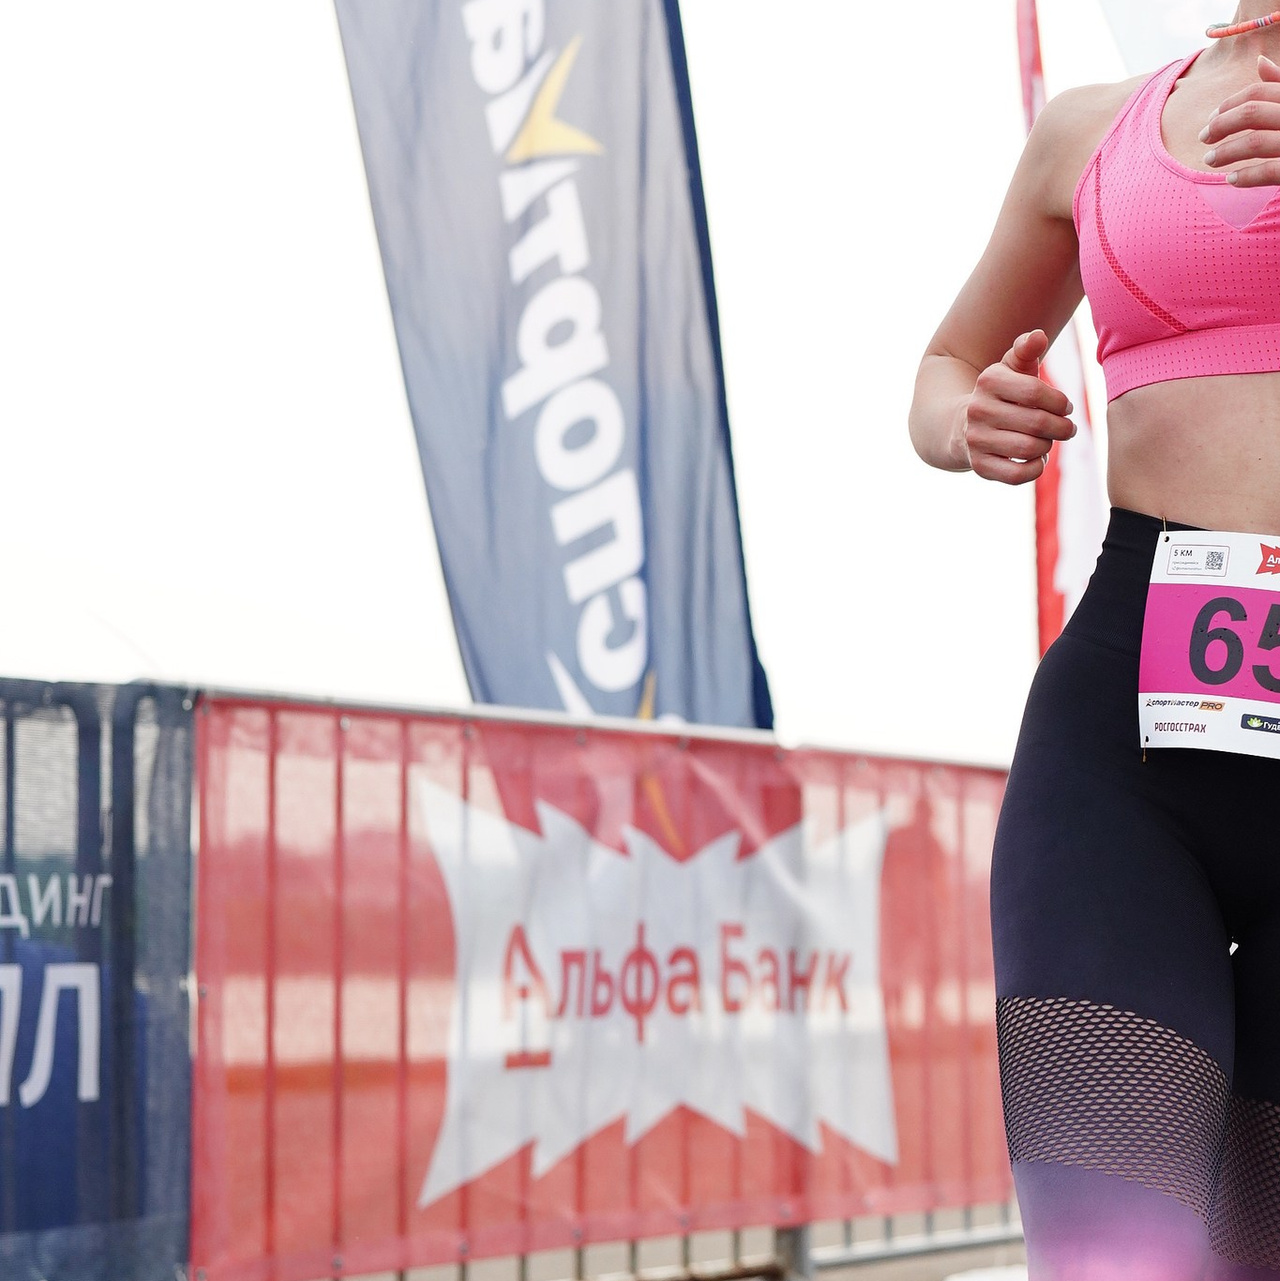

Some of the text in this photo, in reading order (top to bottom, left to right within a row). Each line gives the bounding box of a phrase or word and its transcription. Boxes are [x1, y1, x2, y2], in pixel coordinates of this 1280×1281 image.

[1173, 549, 1179, 557] 5
[1200, 701, 1223, 710] PRO
[1154, 722, 1207, 734] РОСГОССТРАХ
[502, 919, 852, 1046] Альфа Банк
